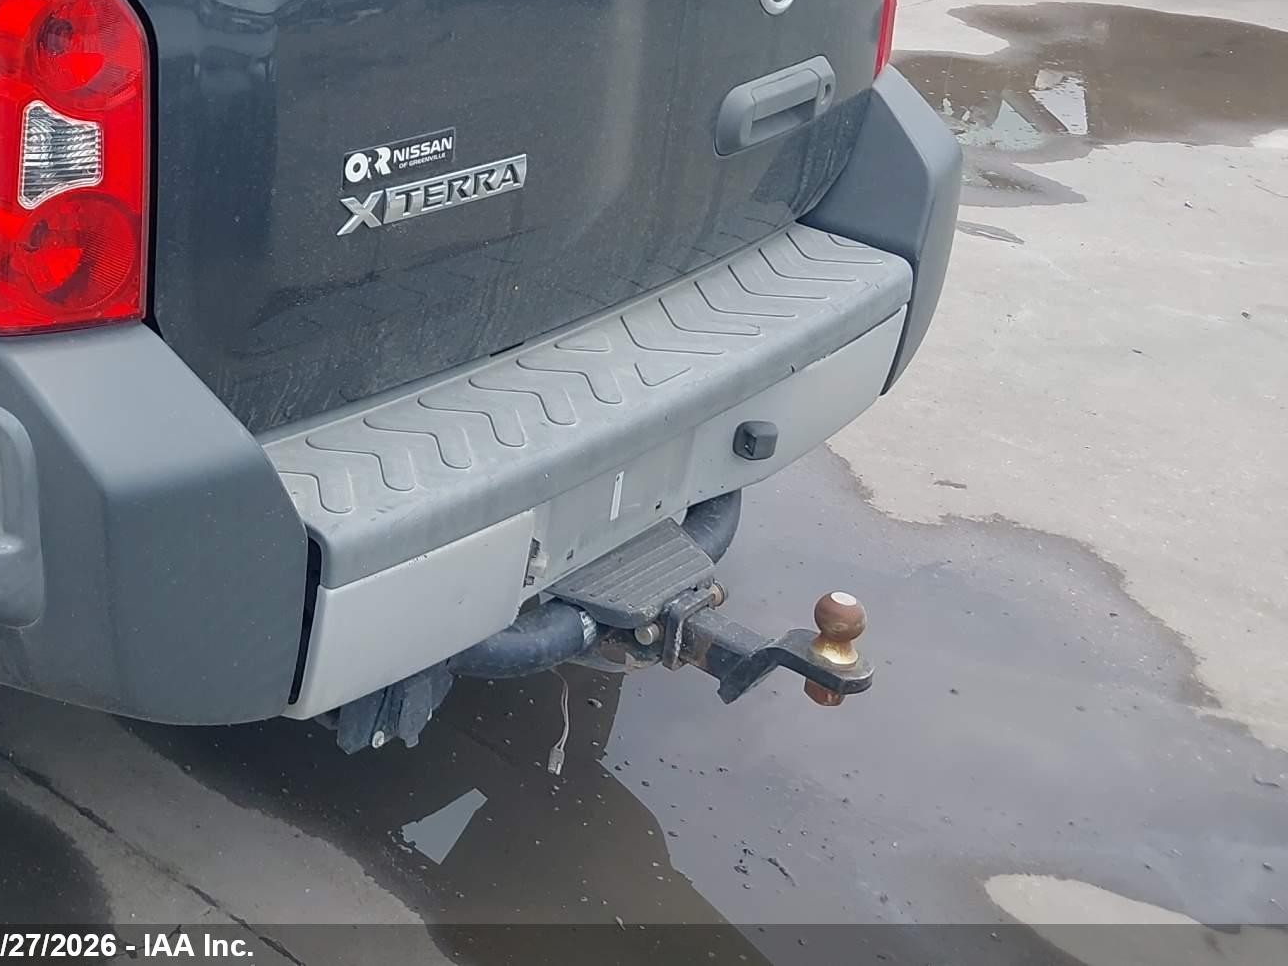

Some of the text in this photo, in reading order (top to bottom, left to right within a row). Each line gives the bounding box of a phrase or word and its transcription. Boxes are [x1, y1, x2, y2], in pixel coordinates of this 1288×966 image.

[393, 136, 453, 163] NISSAN
[409, 152, 446, 167] GREENVILLE
[337, 155, 525, 236] XTERRA
